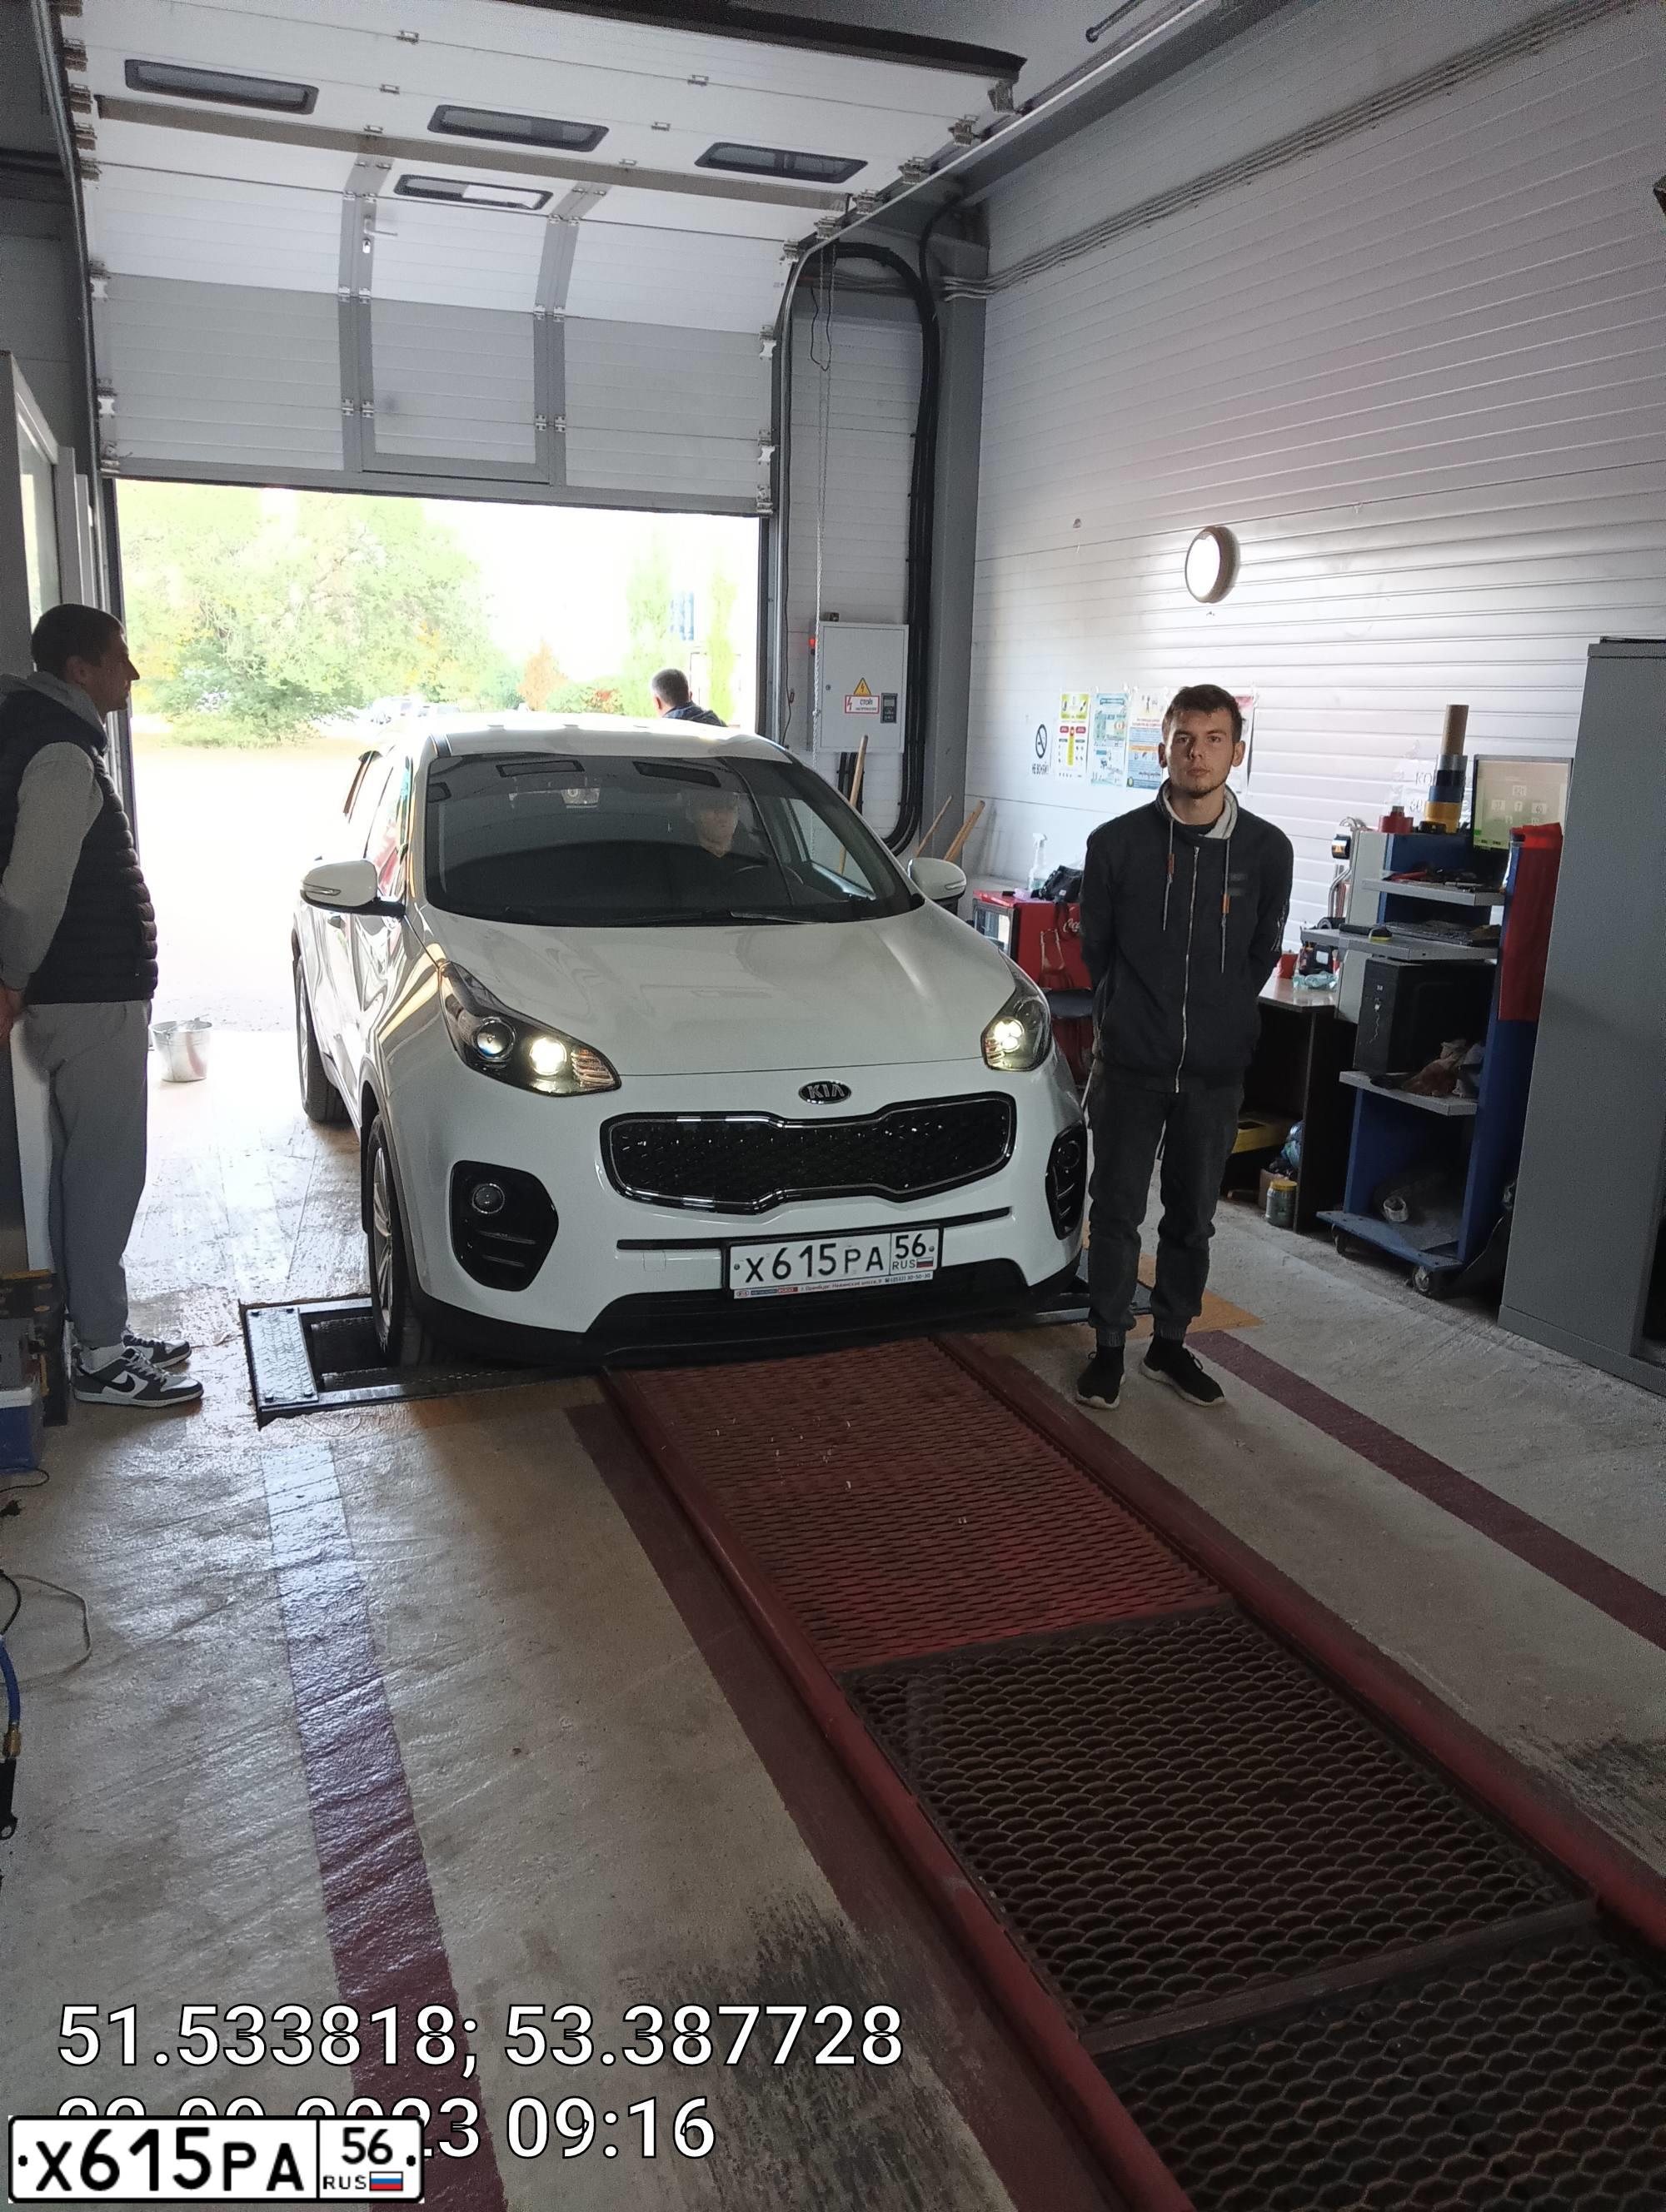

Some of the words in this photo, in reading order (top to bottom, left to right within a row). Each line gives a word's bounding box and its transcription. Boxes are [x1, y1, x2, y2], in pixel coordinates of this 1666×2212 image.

[806, 1084, 845, 1099] KIA
[895, 1233, 926, 1259] 56
[891, 1258, 916, 1271] RUS
